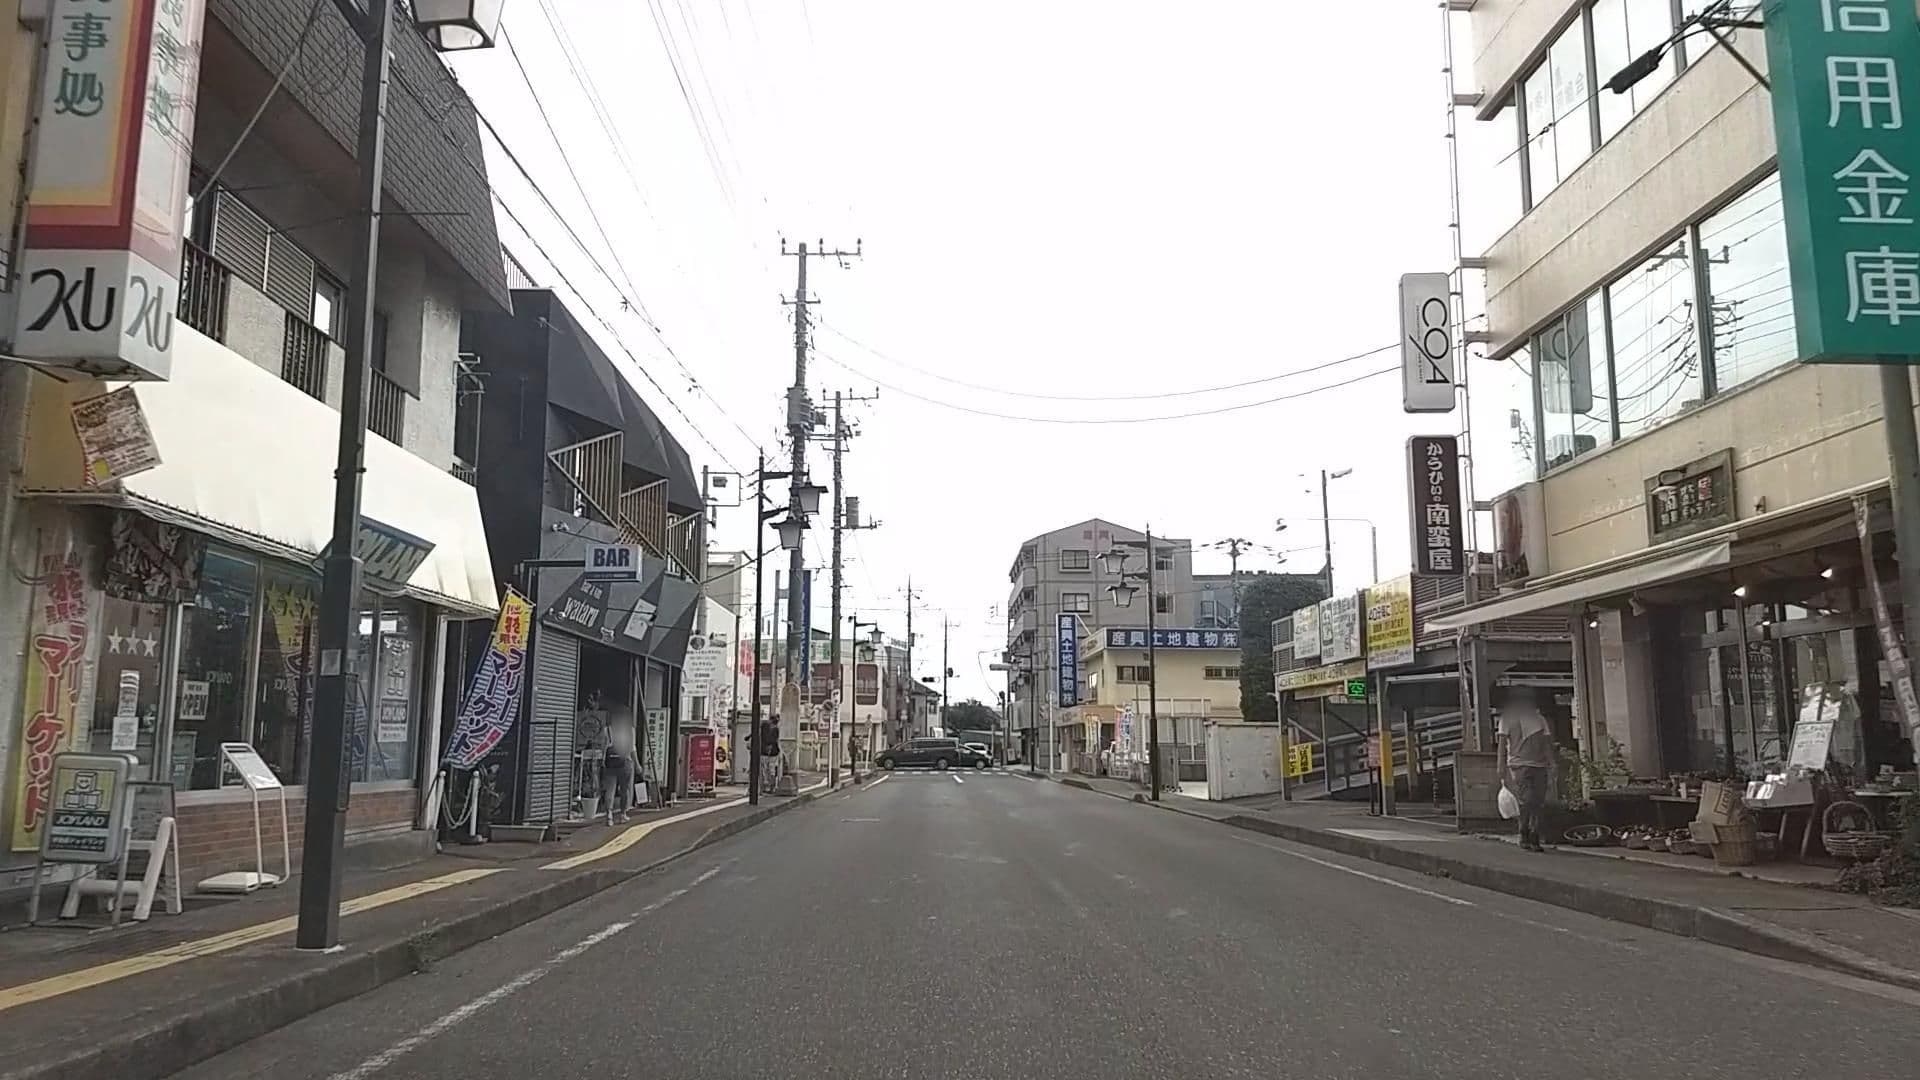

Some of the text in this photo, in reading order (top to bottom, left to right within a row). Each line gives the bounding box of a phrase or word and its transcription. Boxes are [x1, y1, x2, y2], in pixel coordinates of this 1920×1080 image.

[54, 0, 111, 117] 事処
[593, 548, 630, 567] BAR
[563, 597, 600, 628] wataru
[497, 646, 524, 722] フリー
[182, 693, 208, 717] OPEN
[452, 649, 508, 755] マーケット
[56, 815, 105, 827] JOYLAND
